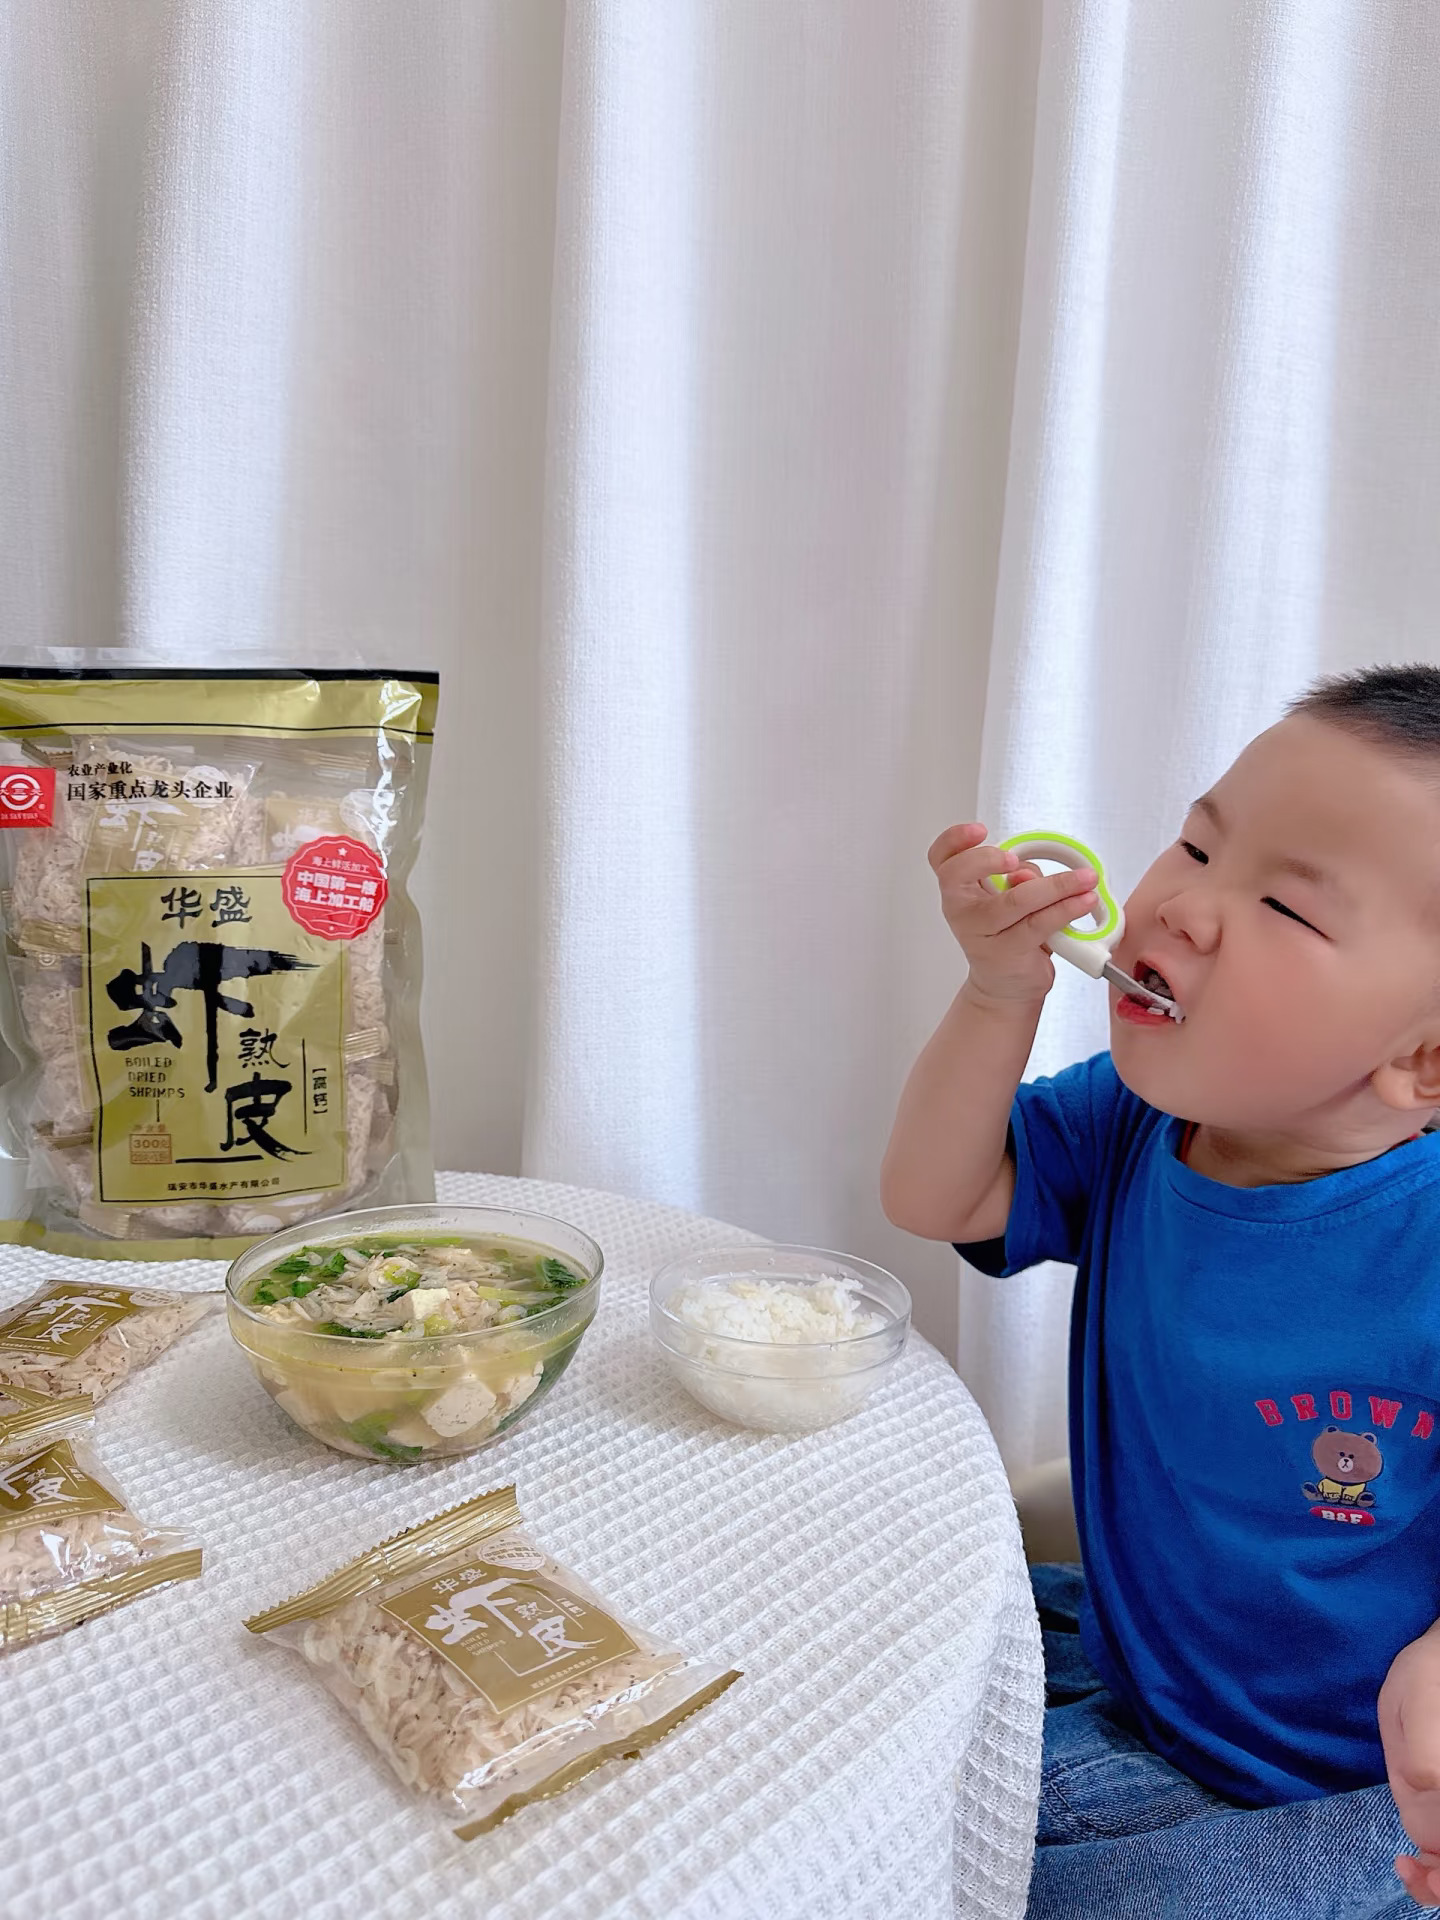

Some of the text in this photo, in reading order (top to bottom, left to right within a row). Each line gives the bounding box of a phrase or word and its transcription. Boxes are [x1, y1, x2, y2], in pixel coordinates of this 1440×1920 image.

[67, 761, 133, 777] 农业产业化
[67, 779, 234, 801] 国家重点龙头企业
[160, 886, 253, 929] 华盛
[294, 886, 375, 913] 海上加工船
[125, 1056, 173, 1068] BOILED
[128, 1071, 167, 1083] DRIED
[129, 1086, 185, 1099] SHRIMPS
[1255, 1390, 1435, 1440] BROWN
